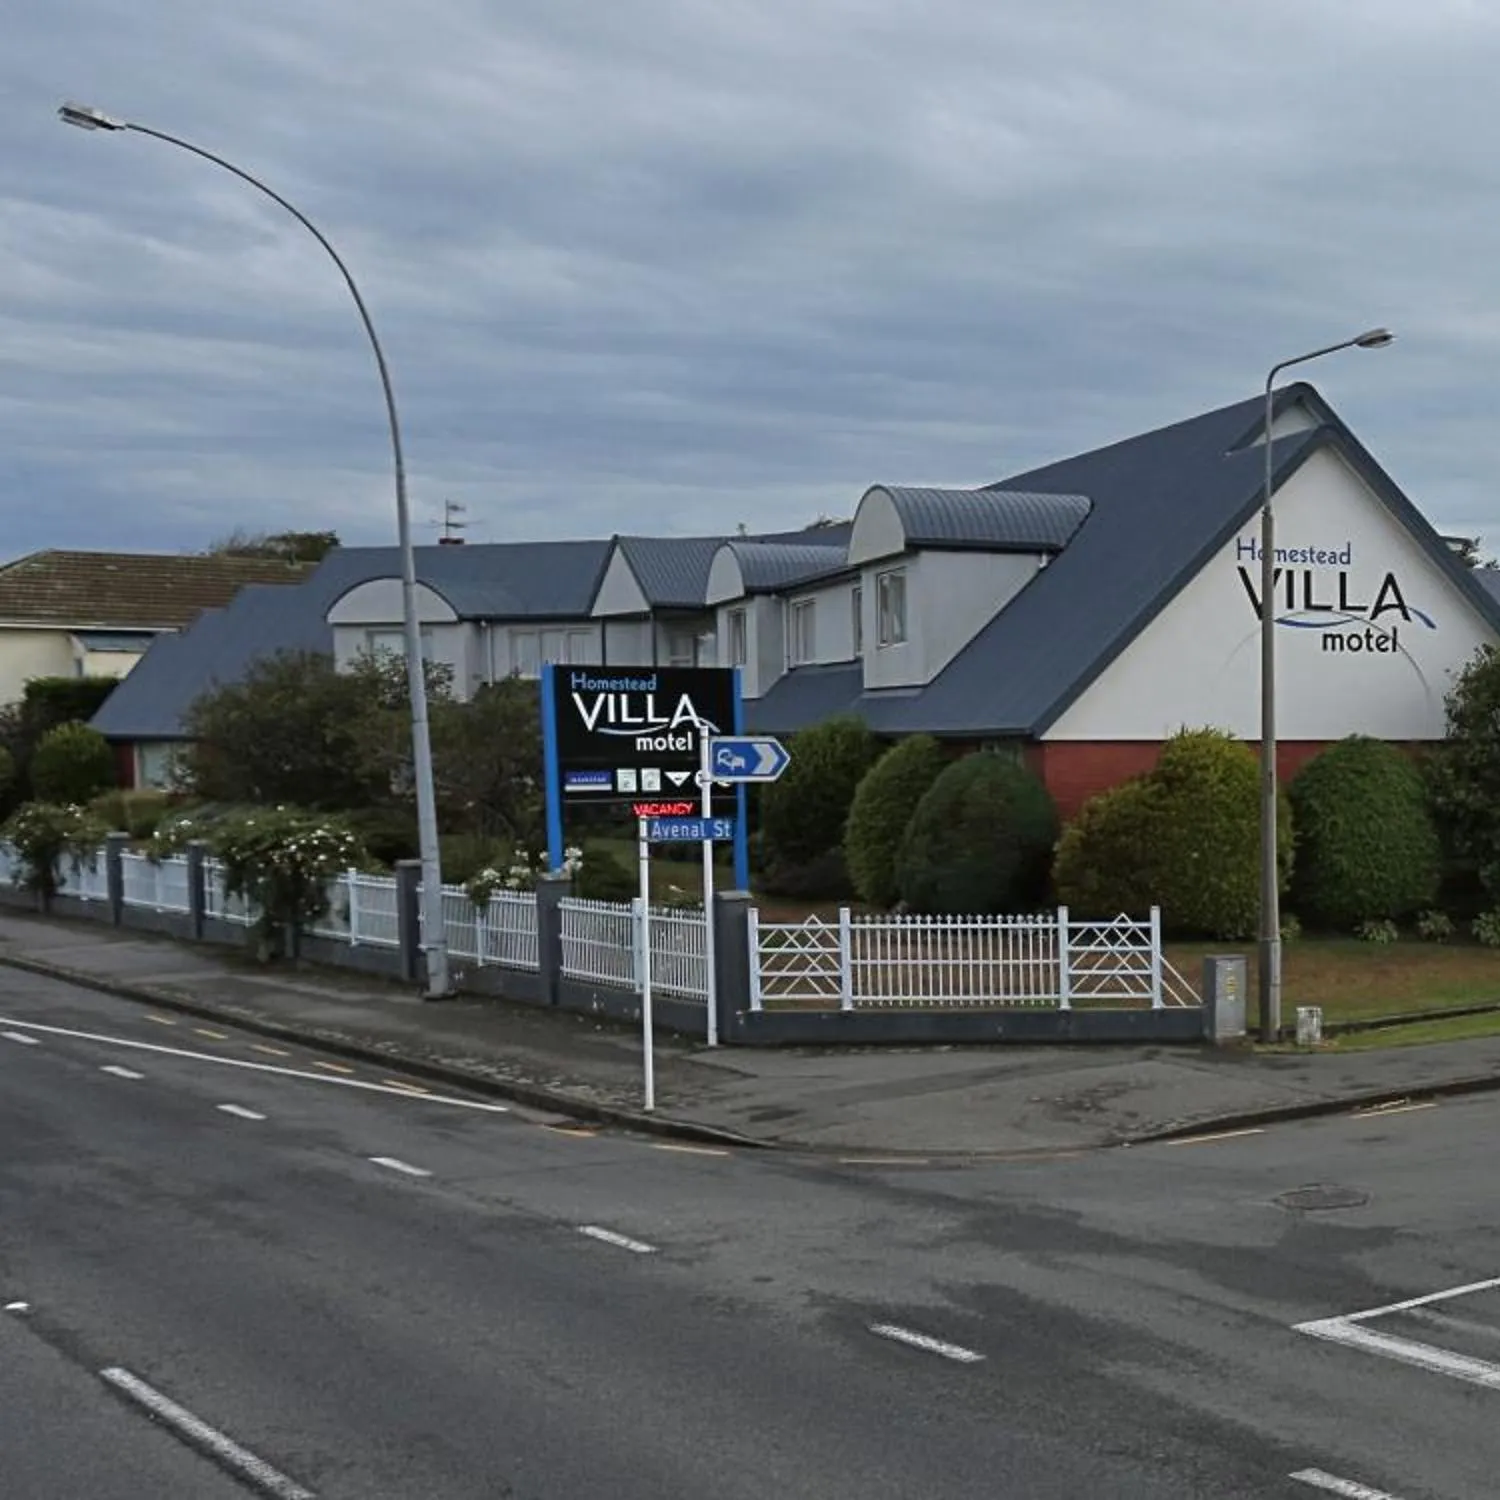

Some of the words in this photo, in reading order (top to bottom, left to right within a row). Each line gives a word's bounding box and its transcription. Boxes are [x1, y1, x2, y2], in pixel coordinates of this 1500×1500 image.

[1237, 566, 1412, 622] VILLA
[1321, 626, 1398, 653] motel
[571, 671, 657, 692] Homestead
[571, 692, 703, 732] VILLA
[635, 731, 693, 752] motel
[633, 802, 694, 816] VACANCY
[652, 819, 706, 838] Avenal
[714, 819, 731, 837] St
